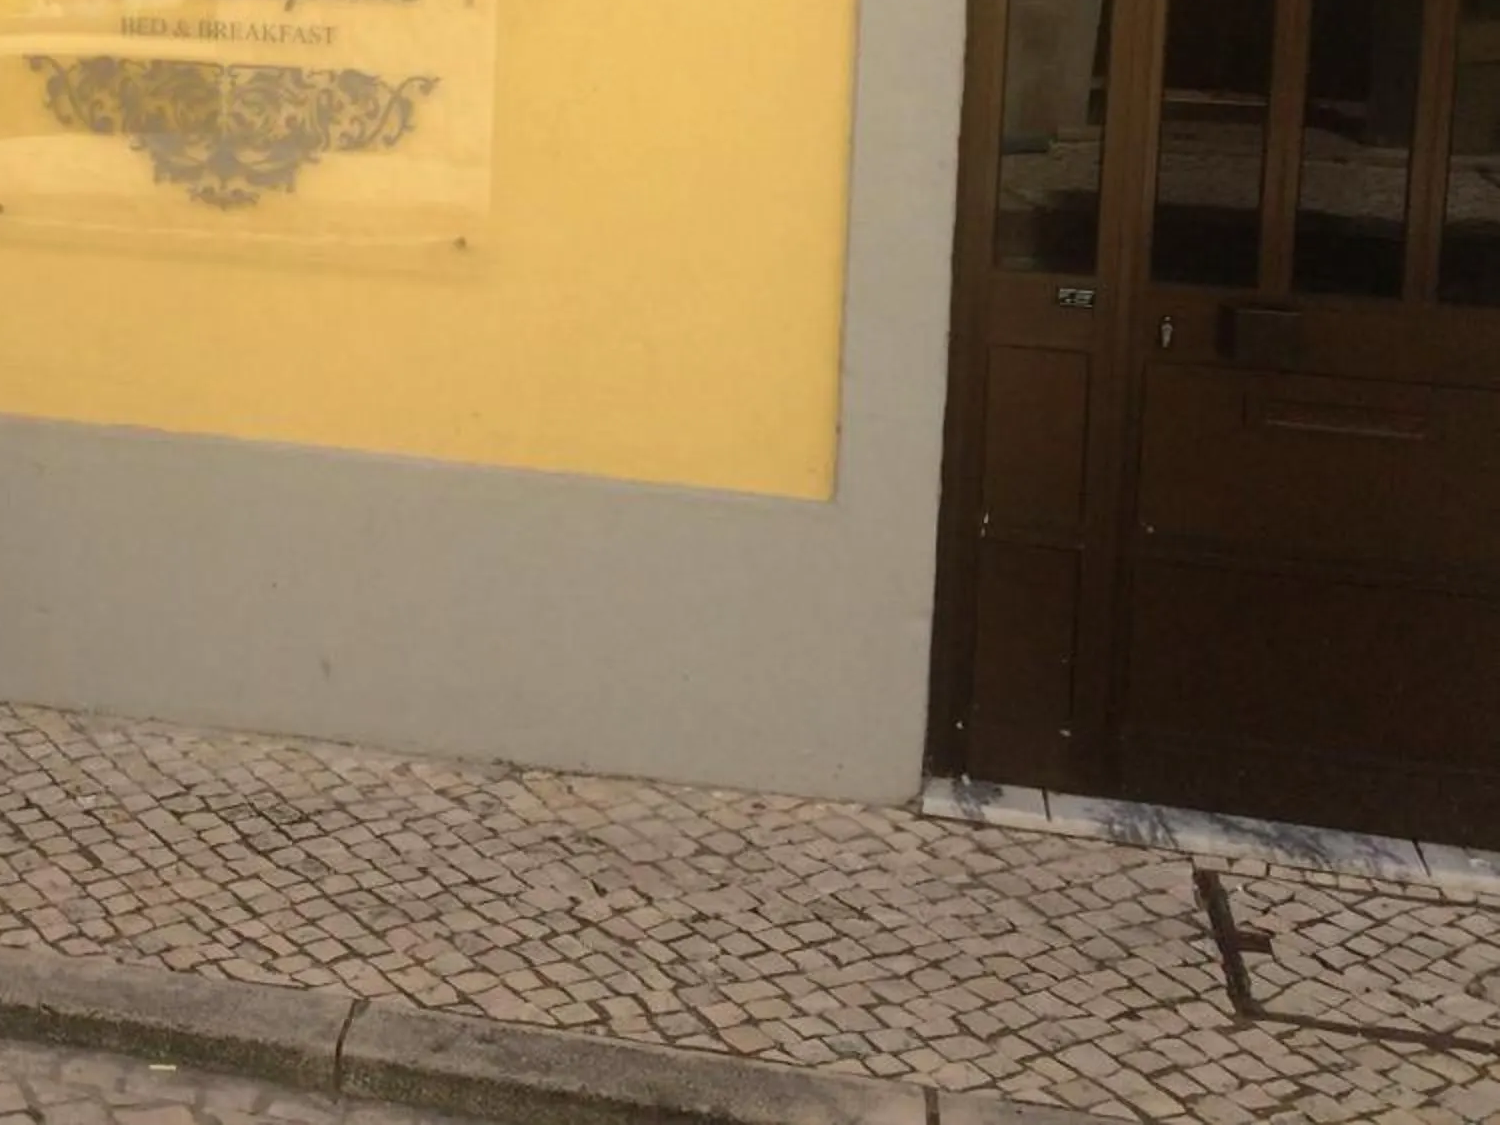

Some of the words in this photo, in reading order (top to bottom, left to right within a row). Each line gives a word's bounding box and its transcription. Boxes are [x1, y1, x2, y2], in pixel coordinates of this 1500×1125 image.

[120, 16, 168, 39] BED
[172, 20, 192, 39] &
[197, 20, 337, 45] BREAKFAST
